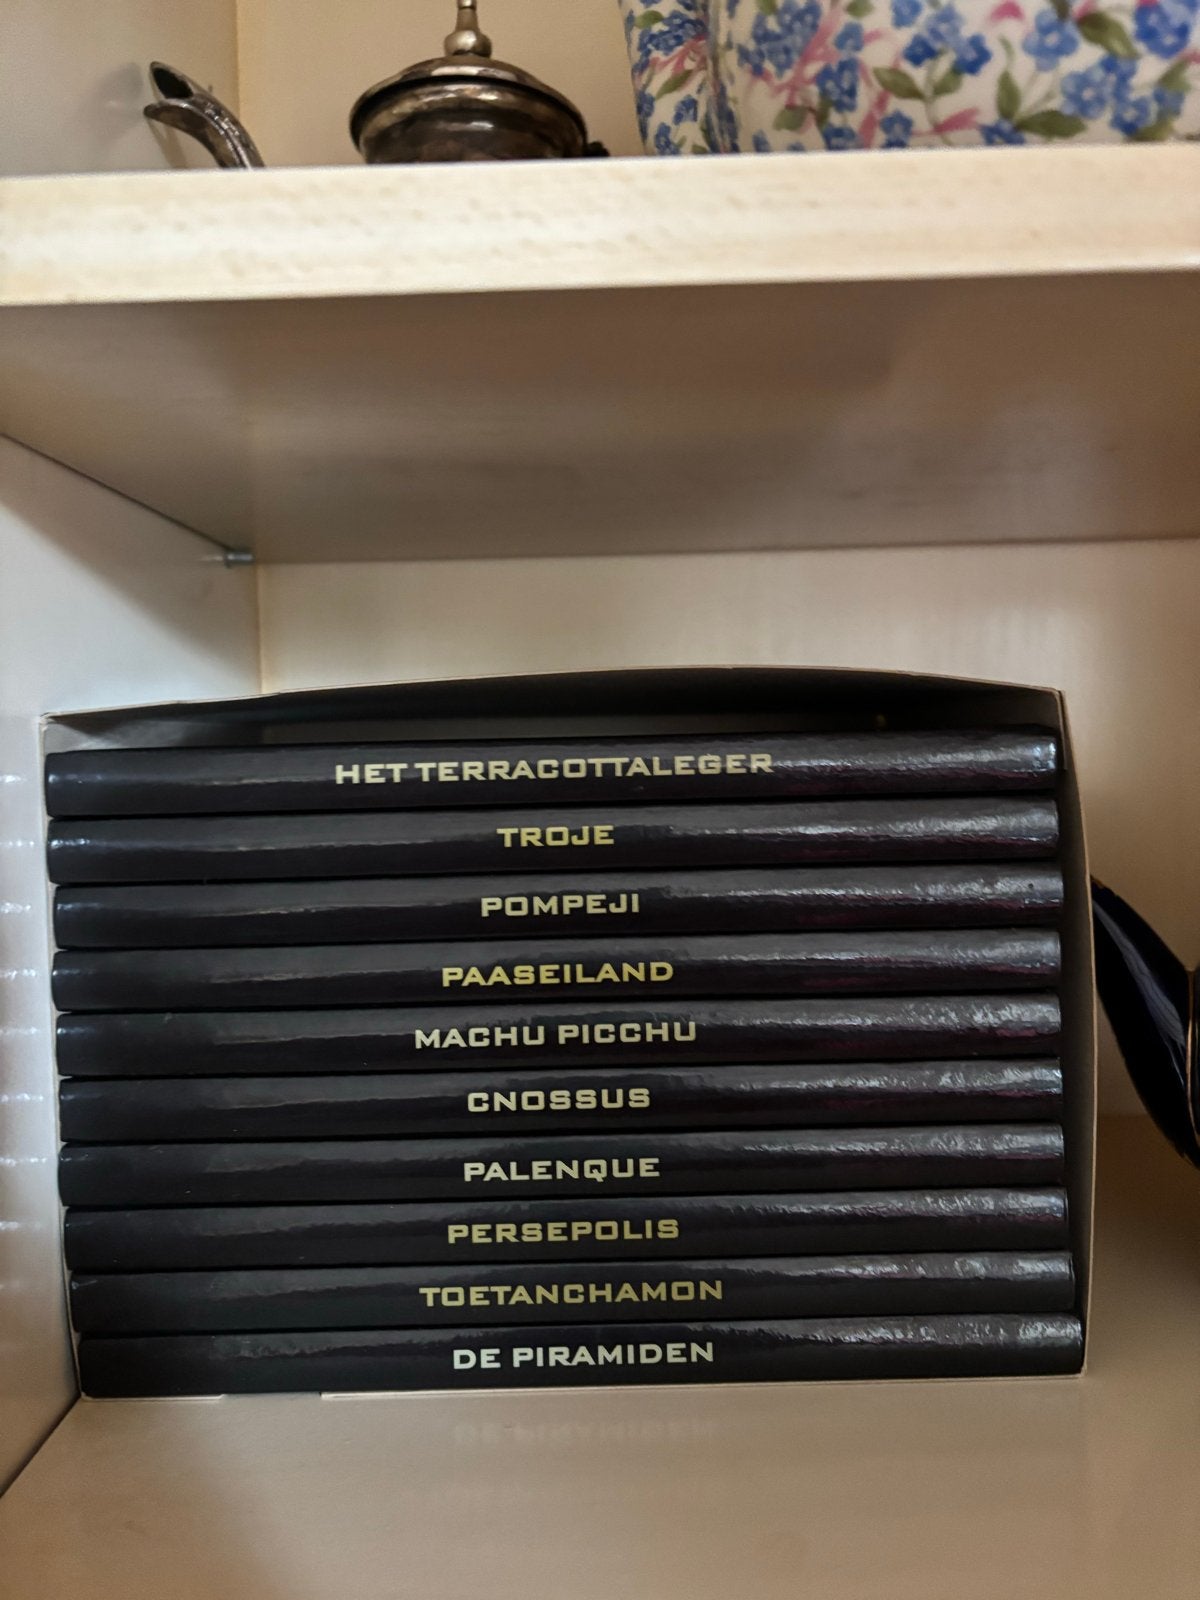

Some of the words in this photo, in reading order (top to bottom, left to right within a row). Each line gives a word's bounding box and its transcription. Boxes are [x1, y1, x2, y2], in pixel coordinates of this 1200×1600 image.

[335, 762, 408, 785] HET
[413, 753, 775, 782] TERRACOTTALEGER
[496, 824, 615, 848] TROJE
[481, 893, 640, 918] POMPEJI
[442, 961, 674, 988] PAASEILAND
[414, 1025, 546, 1050] MACHU
[558, 1020, 697, 1045] PICCHU
[467, 1087, 651, 1113] CNOSSUS
[463, 1157, 660, 1183] PALENQUE
[447, 1219, 680, 1244] PERSEPOLIS
[418, 1280, 724, 1308] TOETANCHAMON
[452, 1348, 502, 1370] DE
[512, 1341, 714, 1367] PIRAMIDEN
